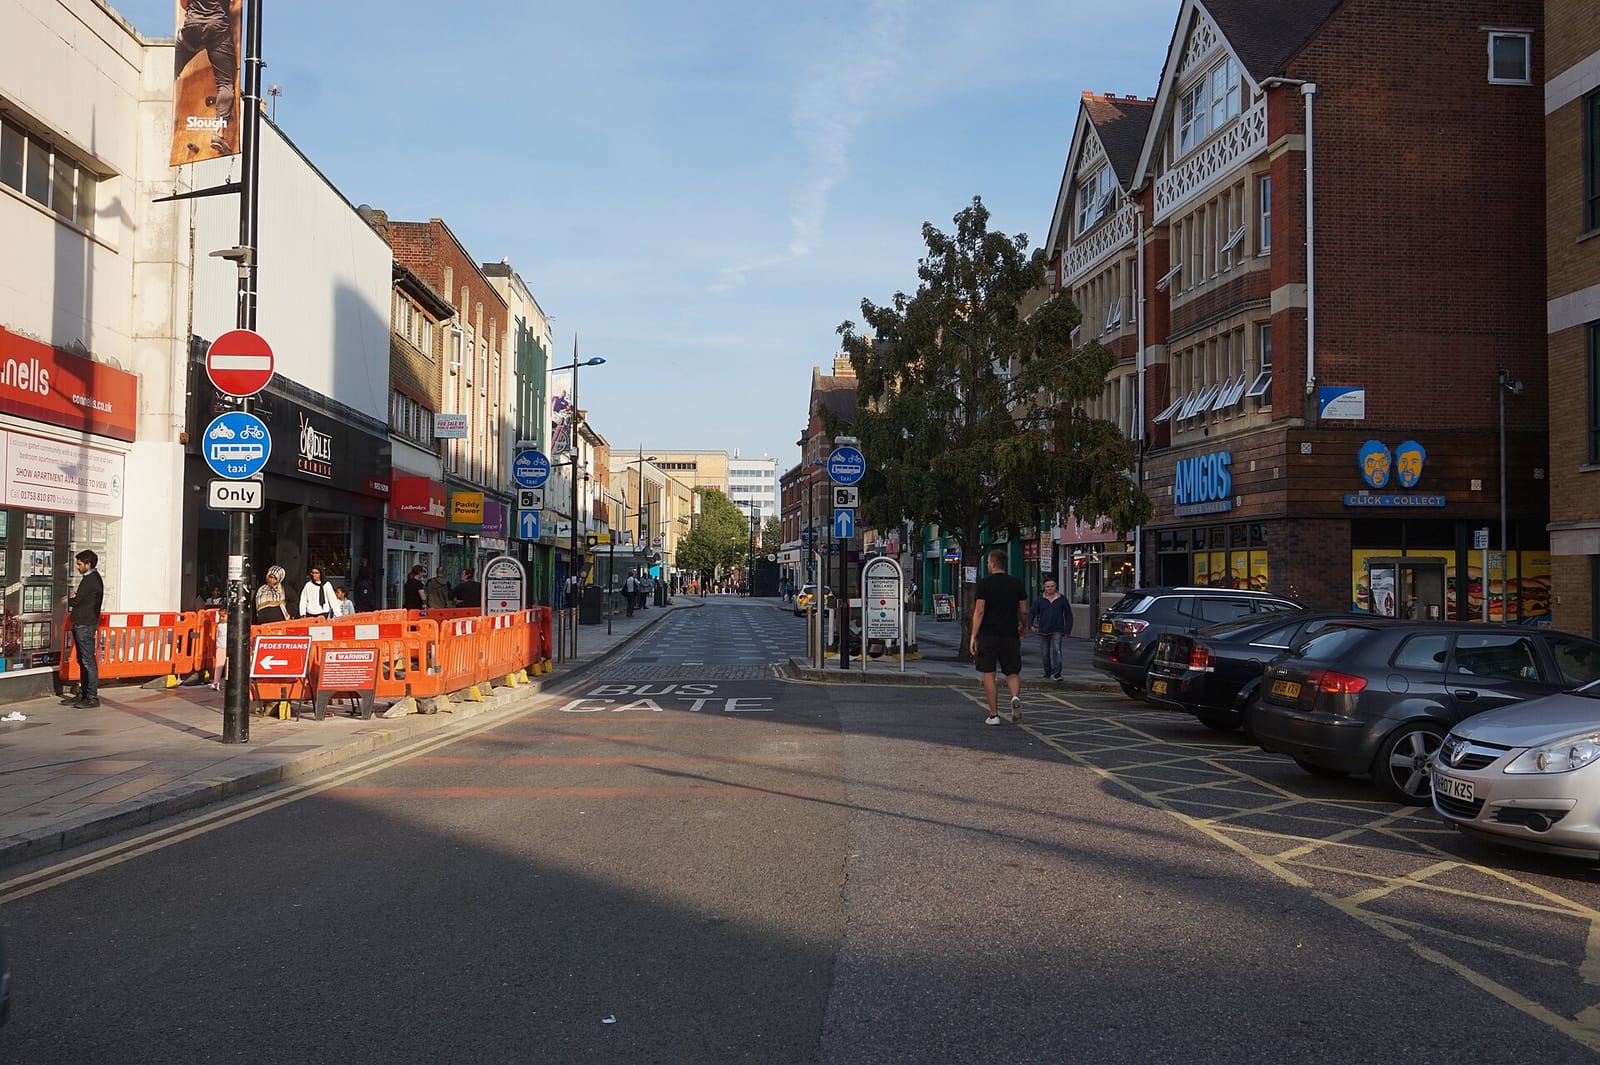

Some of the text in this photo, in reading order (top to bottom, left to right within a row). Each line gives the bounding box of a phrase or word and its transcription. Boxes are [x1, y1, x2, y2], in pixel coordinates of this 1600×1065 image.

[186, 116, 228, 129] Slough
[227, 464, 247, 473] taxi
[16, 467, 108, 489] SHOW APARTMENT AVAILABLE TO VIEW
[1174, 451, 1231, 505] AMIGOS
[20, 490, 37, 501] 01753
[37, 492, 46, 502] 810
[217, 487, 255, 503] Only
[1350, 496, 1381, 505] CLICK
[1393, 496, 1441, 505] COLLECT
[258, 642, 309, 650] PEDESTRIANS
[586, 684, 719, 696] BUS
[559, 697, 774, 713] GATE
[1454, 781, 1473, 799] KZS
